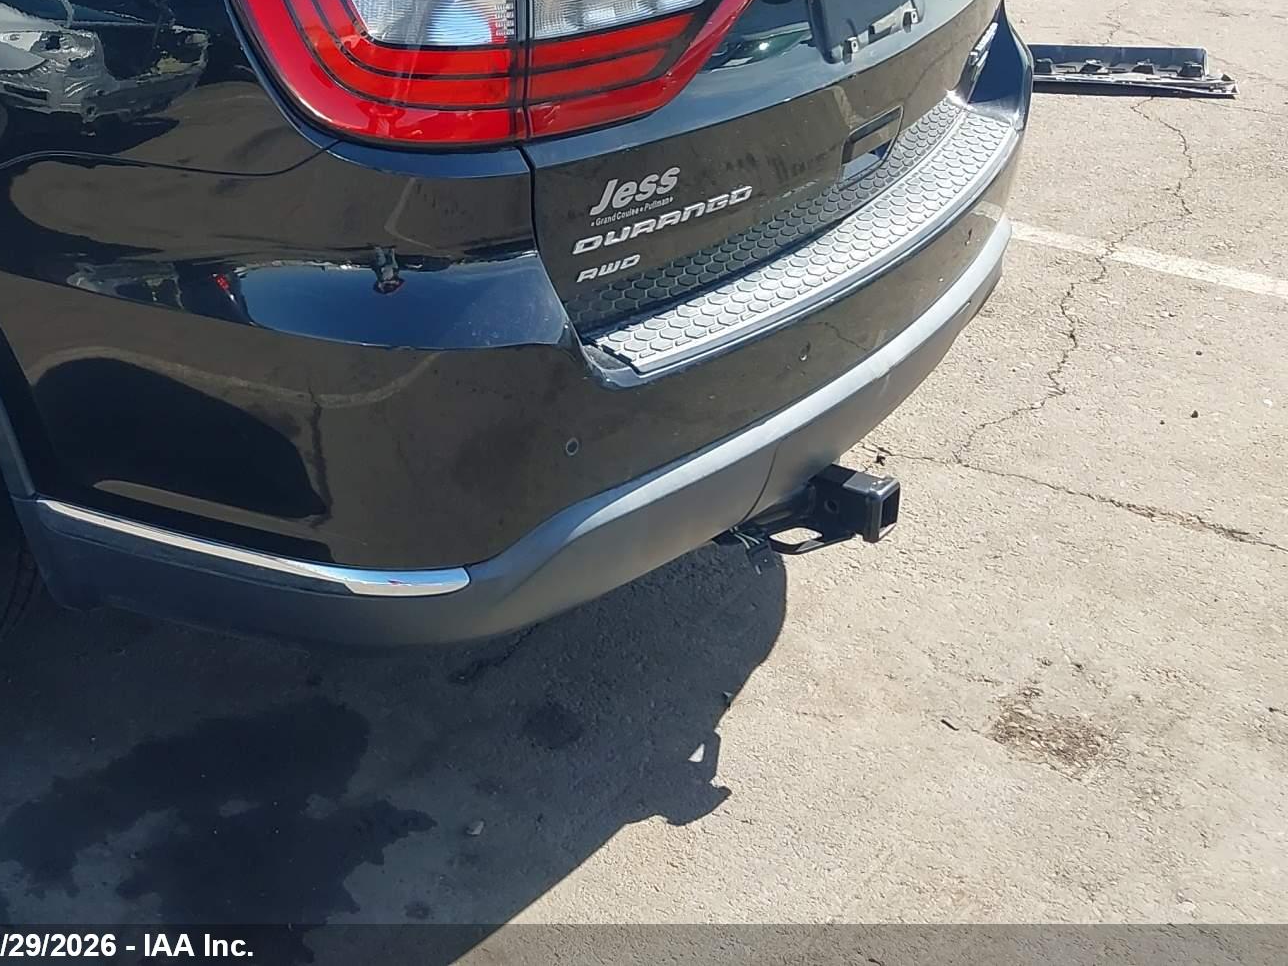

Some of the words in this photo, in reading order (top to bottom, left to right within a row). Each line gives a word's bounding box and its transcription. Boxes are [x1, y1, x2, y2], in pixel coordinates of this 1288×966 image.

[589, 167, 681, 216] Jess
[573, 186, 753, 254] DURANGO
[595, 213, 617, 226] Grand
[616, 208, 640, 220] Coulee
[644, 198, 671, 211] Pullman
[577, 254, 641, 282] AWD
